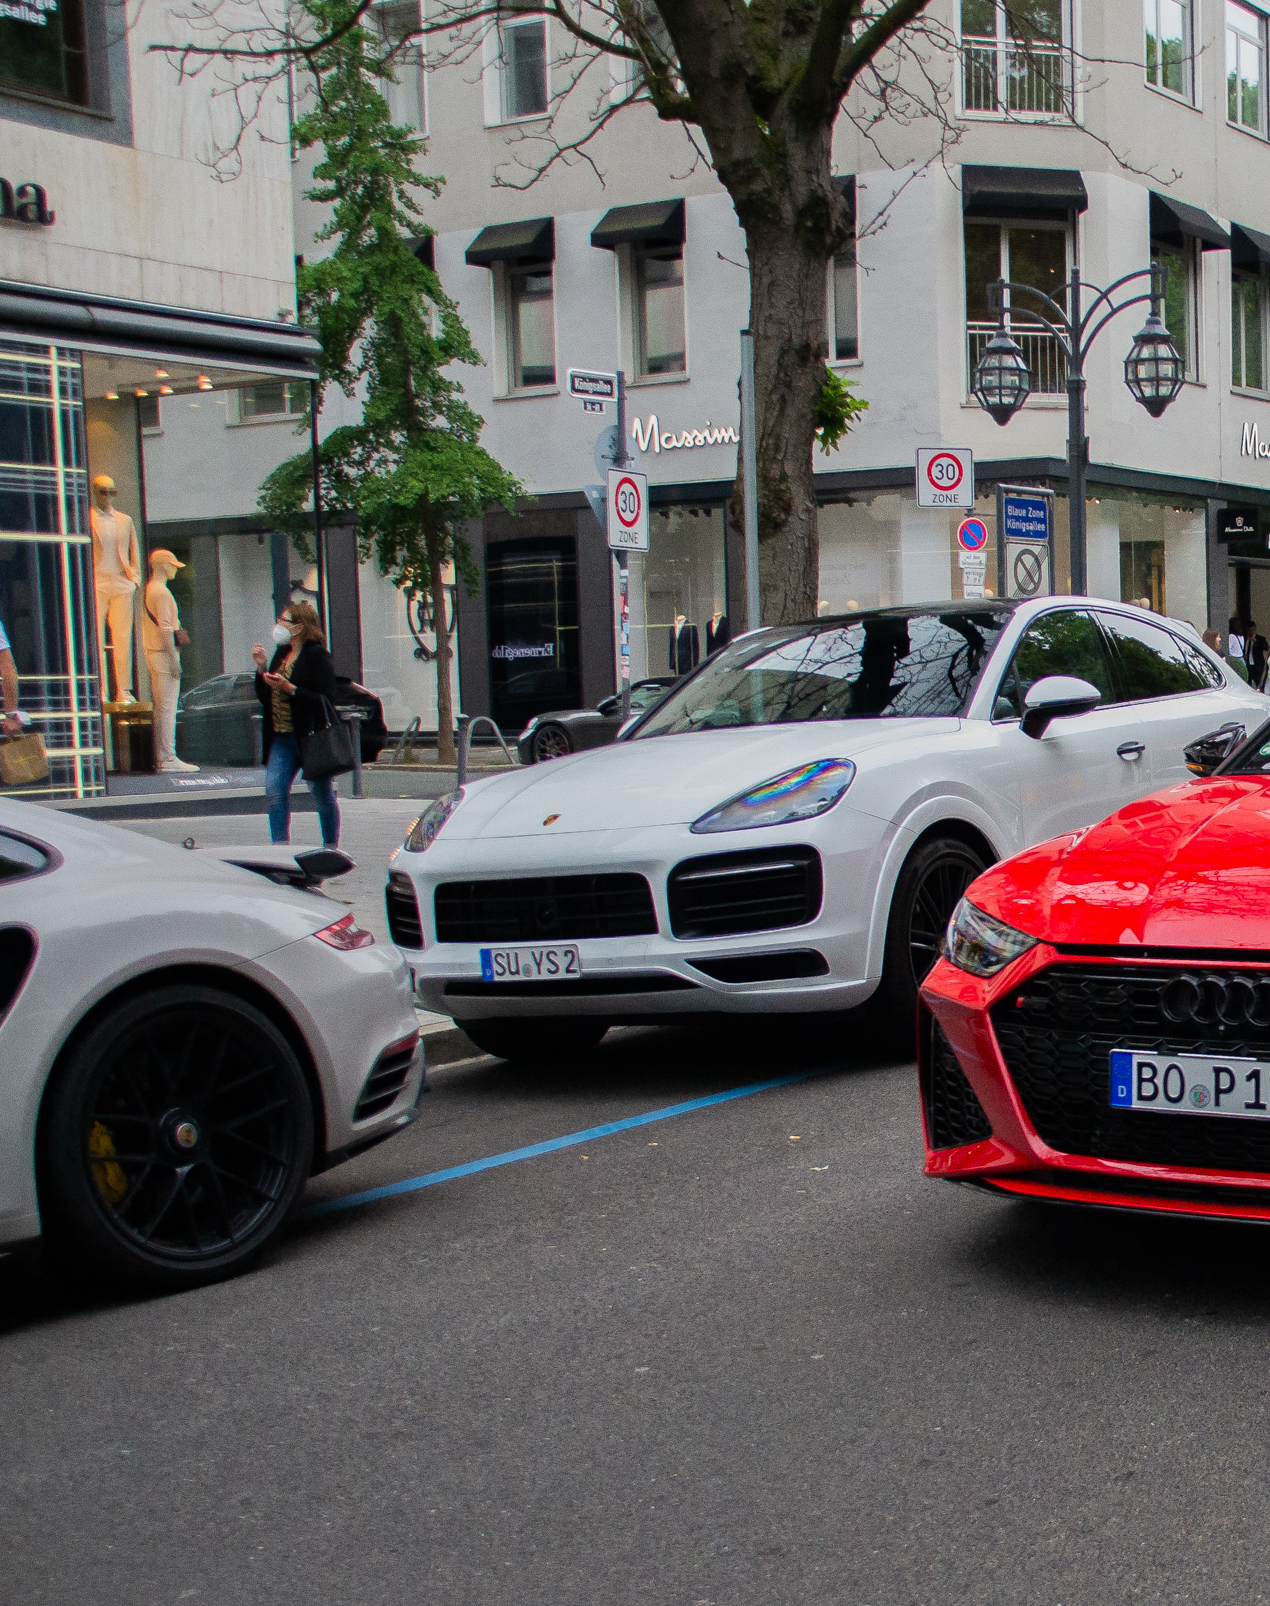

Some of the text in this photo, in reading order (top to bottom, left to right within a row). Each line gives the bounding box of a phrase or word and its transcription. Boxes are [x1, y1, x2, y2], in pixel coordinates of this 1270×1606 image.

[574, 377, 612, 394] Königsallee
[632, 413, 741, 453] Massim
[934, 463, 956, 481] 30
[619, 490, 636, 514] 30
[932, 493, 960, 504] ZONE
[1007, 505, 1045, 519] Blaue Zone
[1006, 518, 1046, 533] Königsallee
[619, 530, 639, 545] ZONE
[494, 952, 521, 977] SU
[1136, 1061, 1186, 1104] BO
